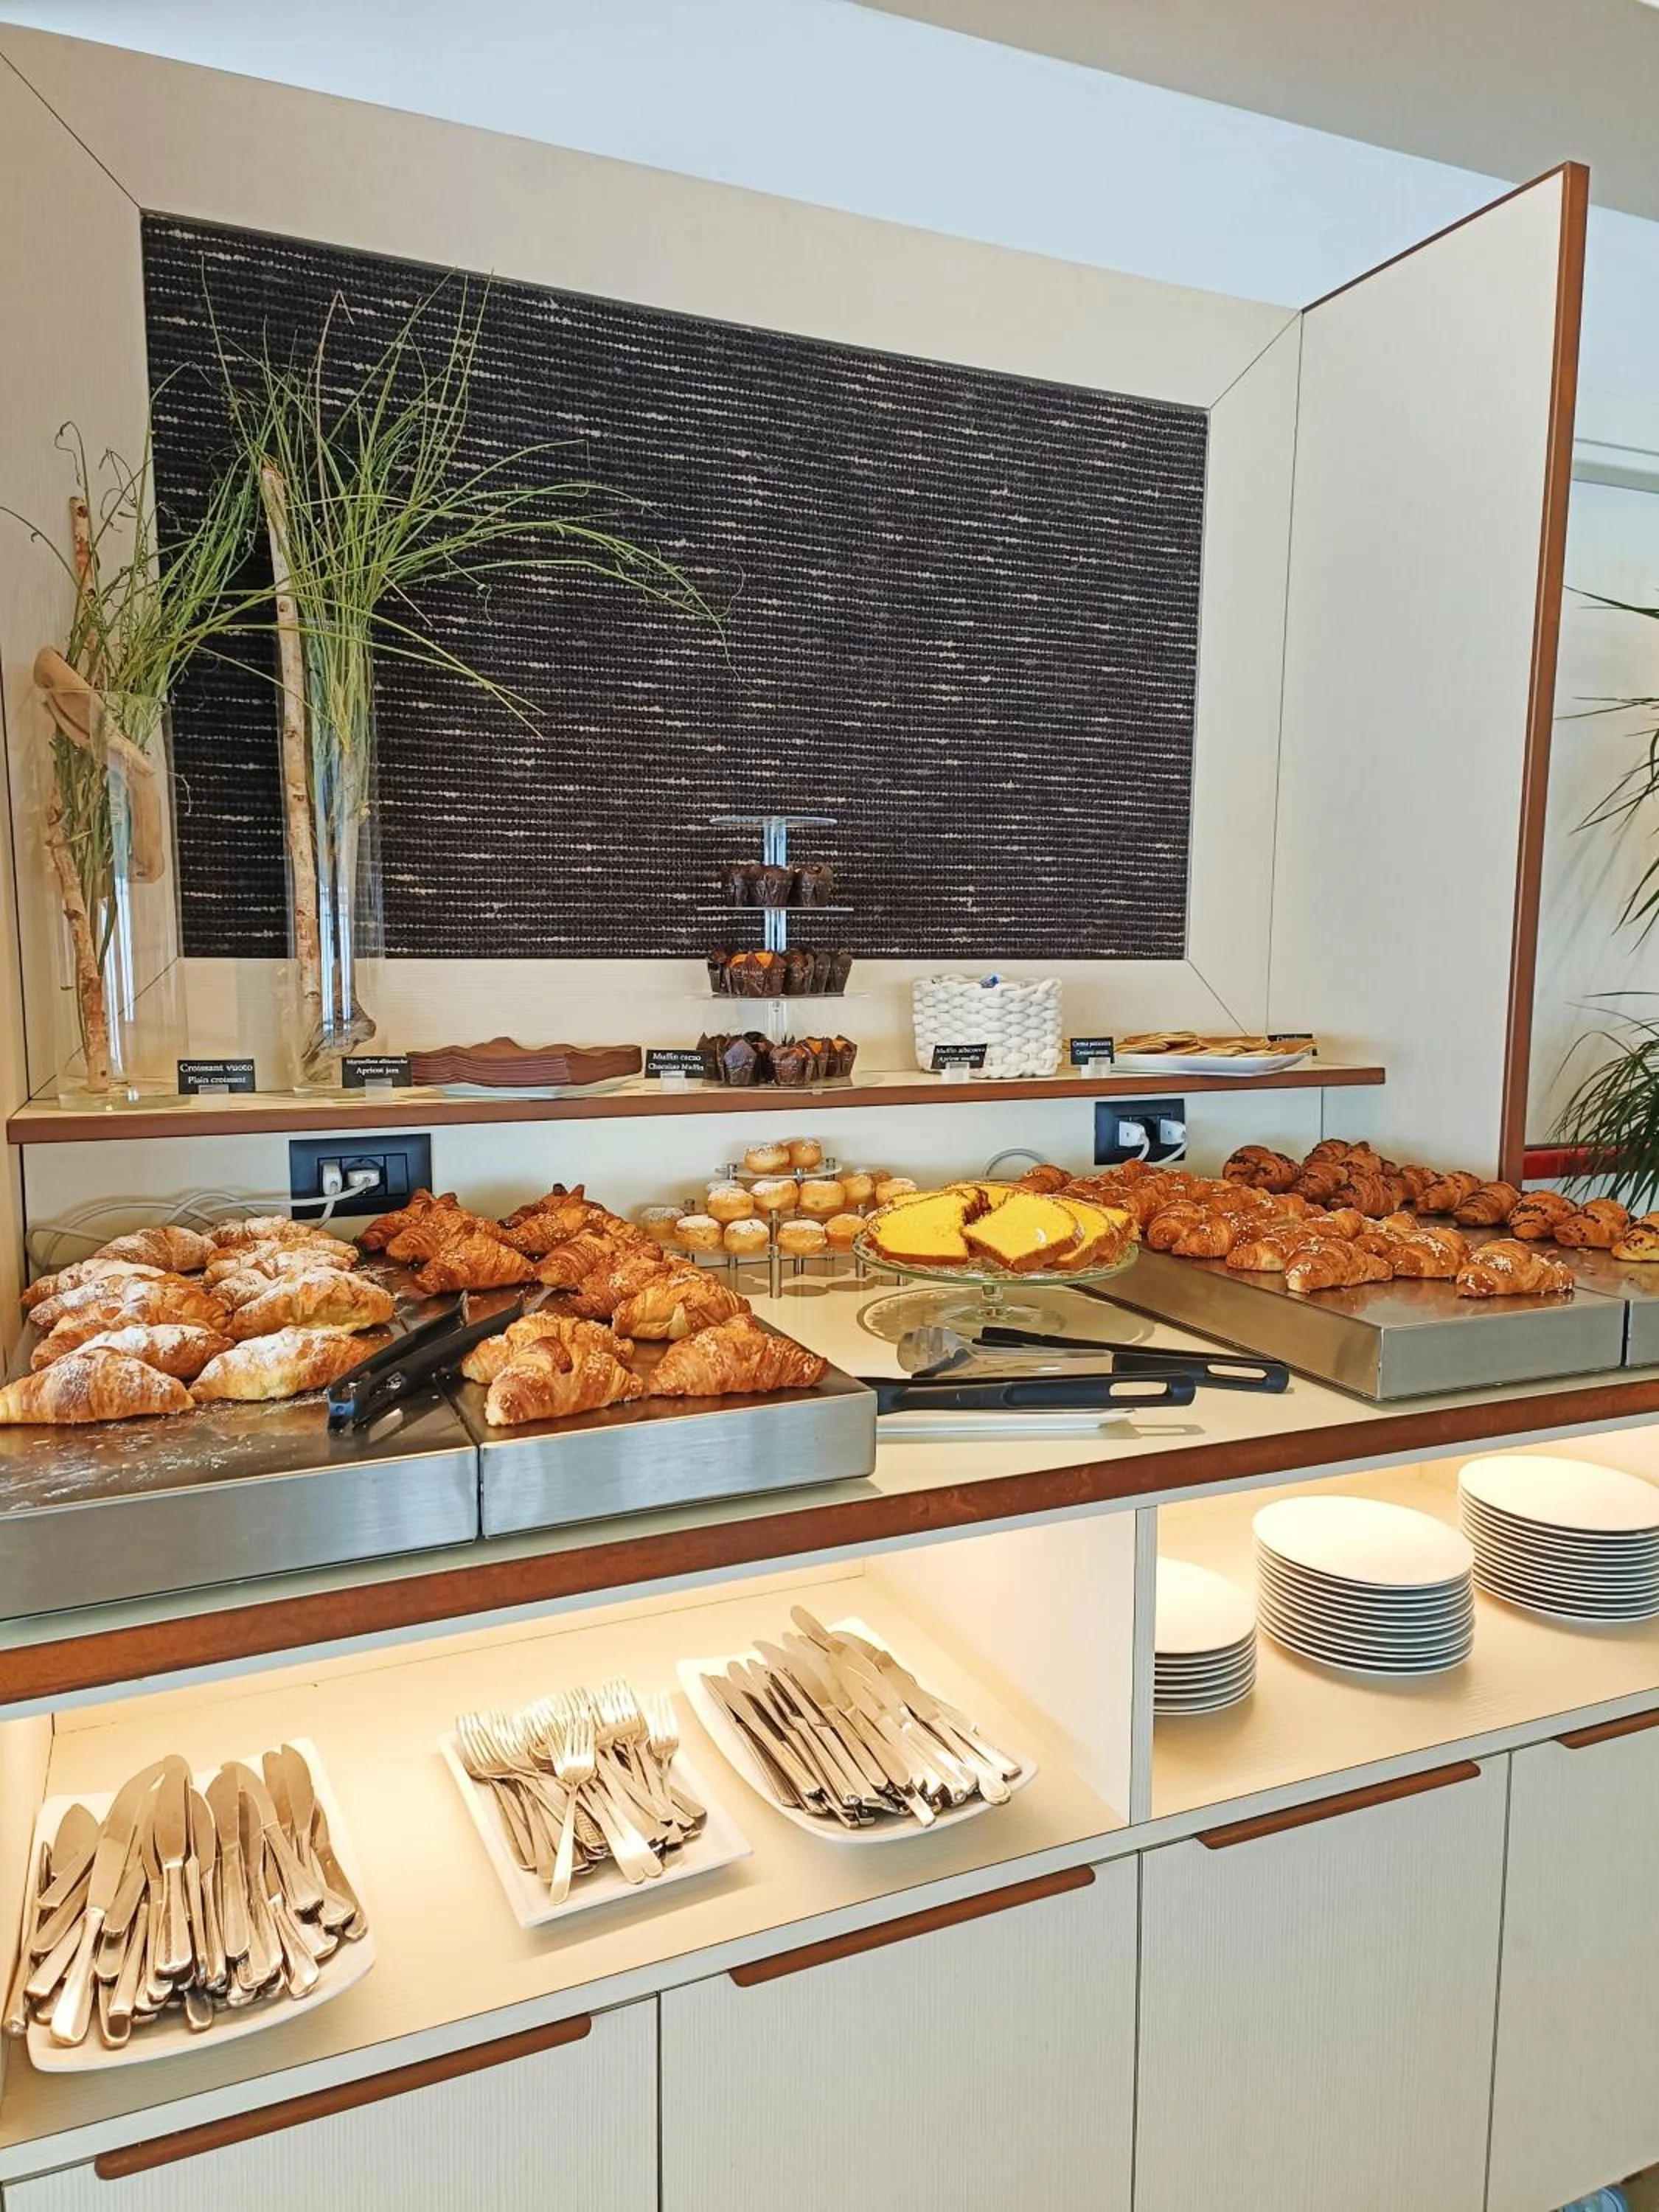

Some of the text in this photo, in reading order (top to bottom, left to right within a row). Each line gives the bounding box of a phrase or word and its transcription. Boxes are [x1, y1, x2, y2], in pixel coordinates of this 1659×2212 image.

[652, 1052, 678, 1060] Muffin
[179, 1063, 223, 1072] Croissant
[356, 1066, 399, 1076] Apricot jam
[188, 1076, 246, 1084] Plain croissant
